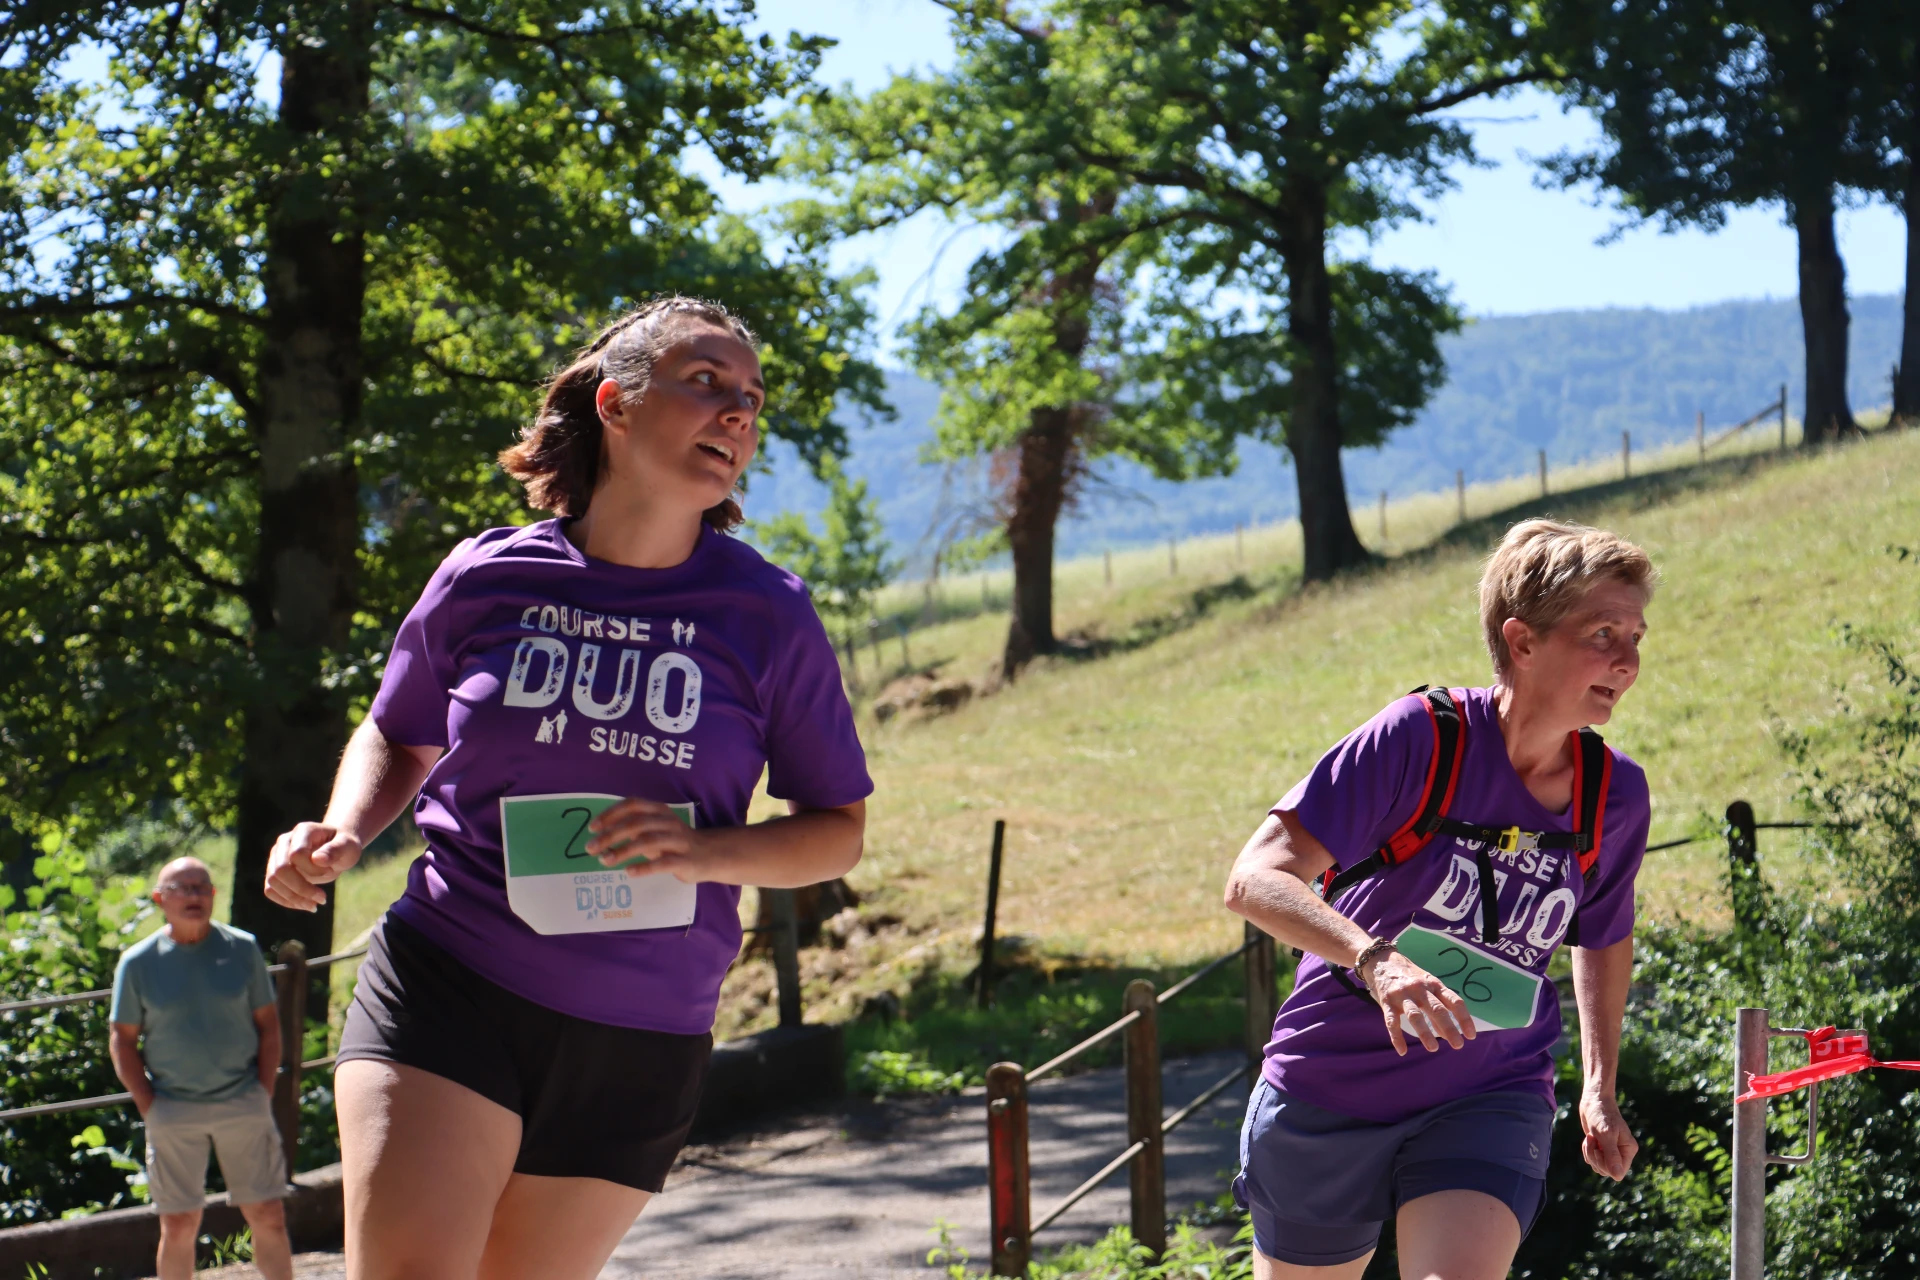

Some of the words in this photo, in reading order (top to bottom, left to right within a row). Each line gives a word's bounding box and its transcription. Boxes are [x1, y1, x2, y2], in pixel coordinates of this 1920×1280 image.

[519, 605, 651, 642] COURSE
[503, 637, 702, 733] DUO
[589, 727, 695, 769] SUISSE
[573, 873, 614, 885] COURSE
[576, 884, 632, 911] DUO
[603, 910, 633, 919] SUISSE
[1423, 854, 1576, 949] DUO
[1437, 947, 1493, 1002] 26
